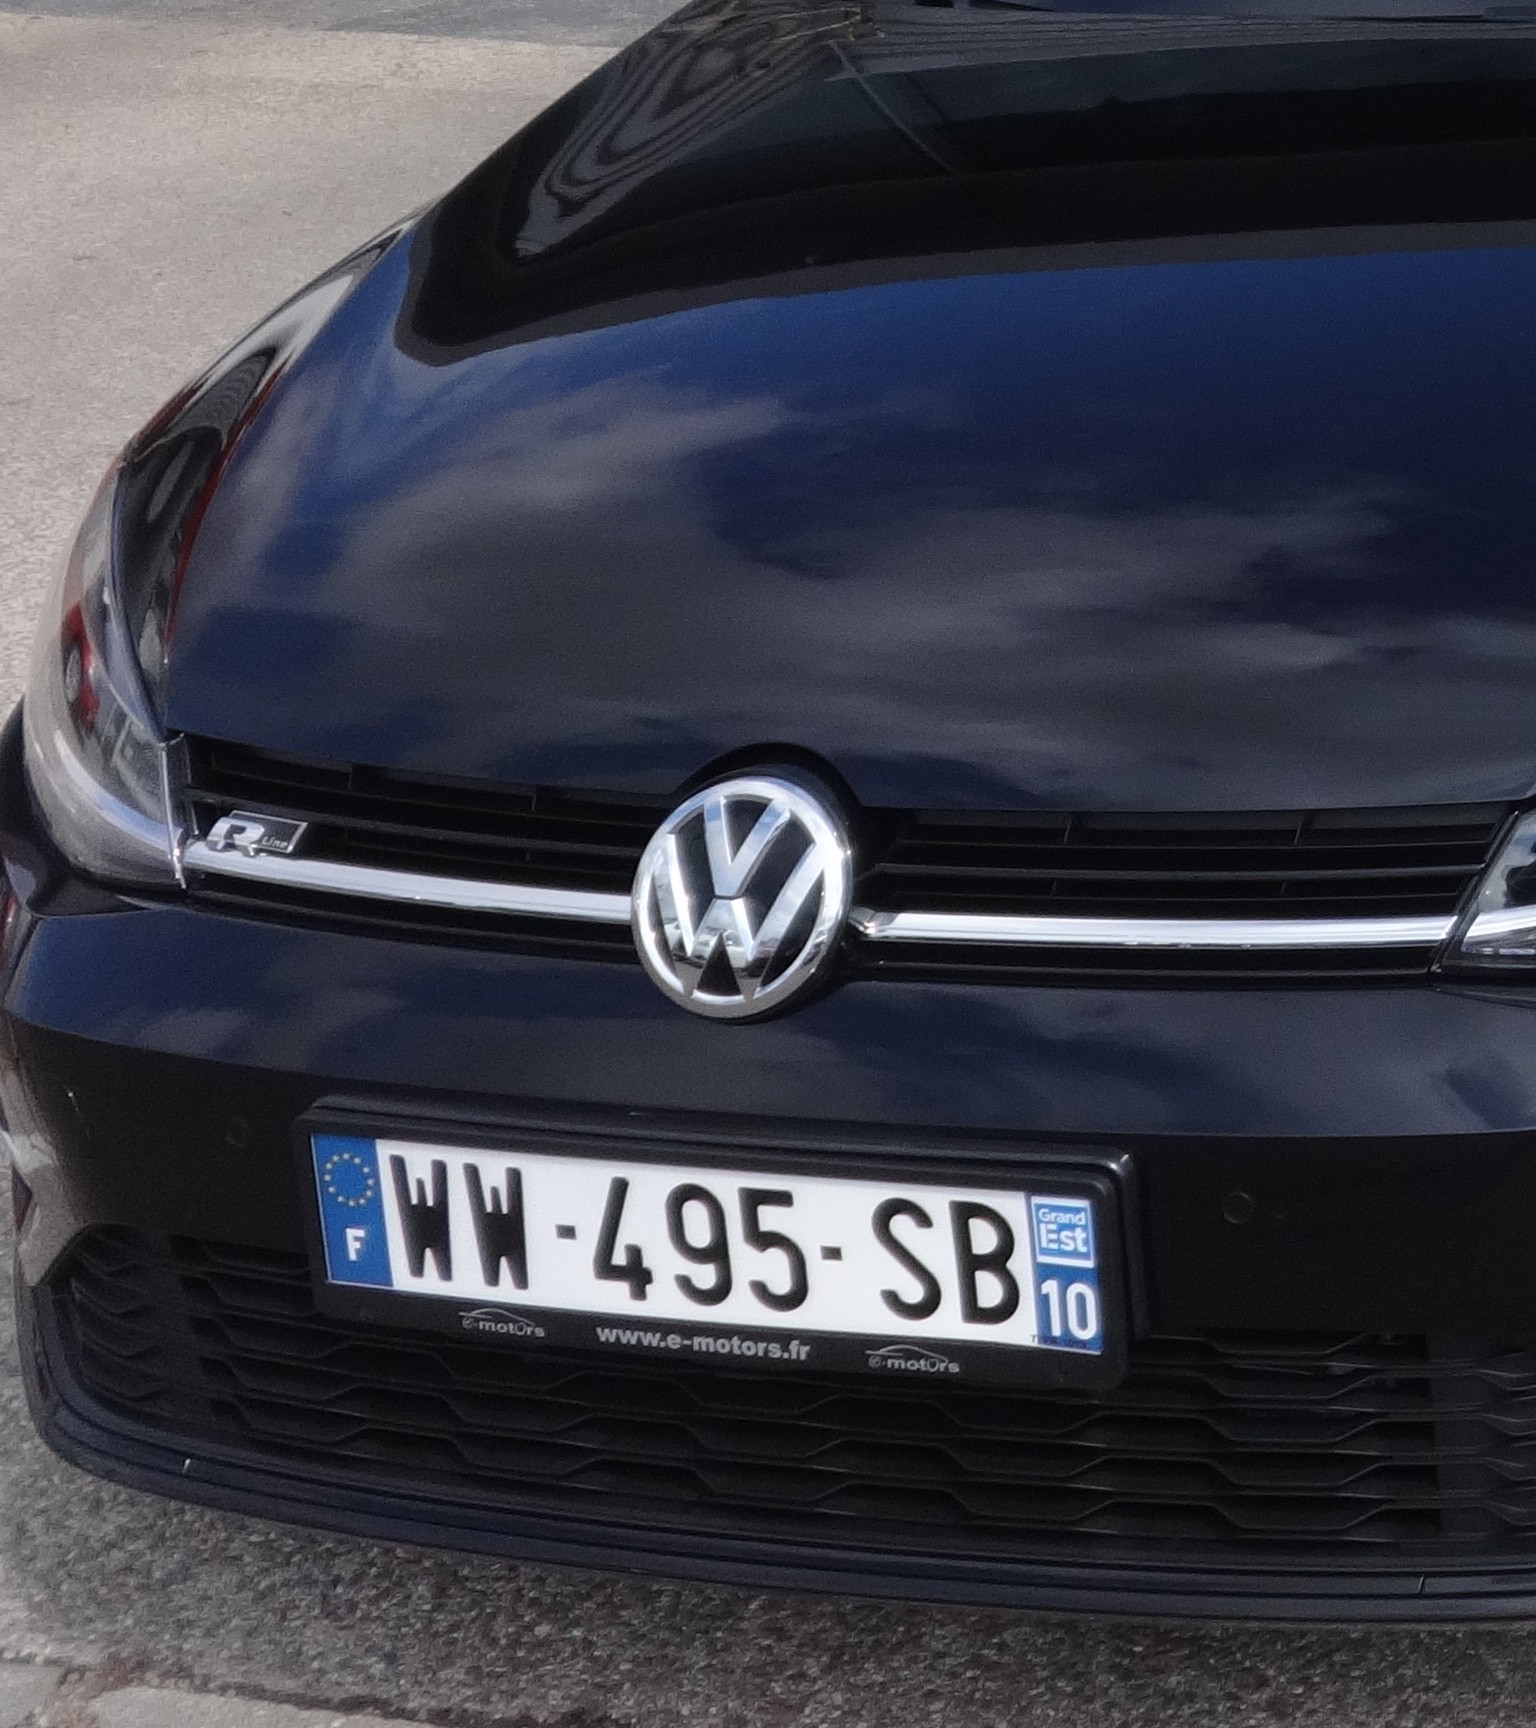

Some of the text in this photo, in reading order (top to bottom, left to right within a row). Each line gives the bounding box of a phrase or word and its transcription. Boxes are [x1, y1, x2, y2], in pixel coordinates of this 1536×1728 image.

[1038, 1208, 1087, 1226] Grand
[345, 1227, 366, 1262] F
[1039, 1223, 1088, 1253] Est
[1041, 1279, 1097, 1340] 10
[595, 1326, 812, 1361] www.e-motors.fr
